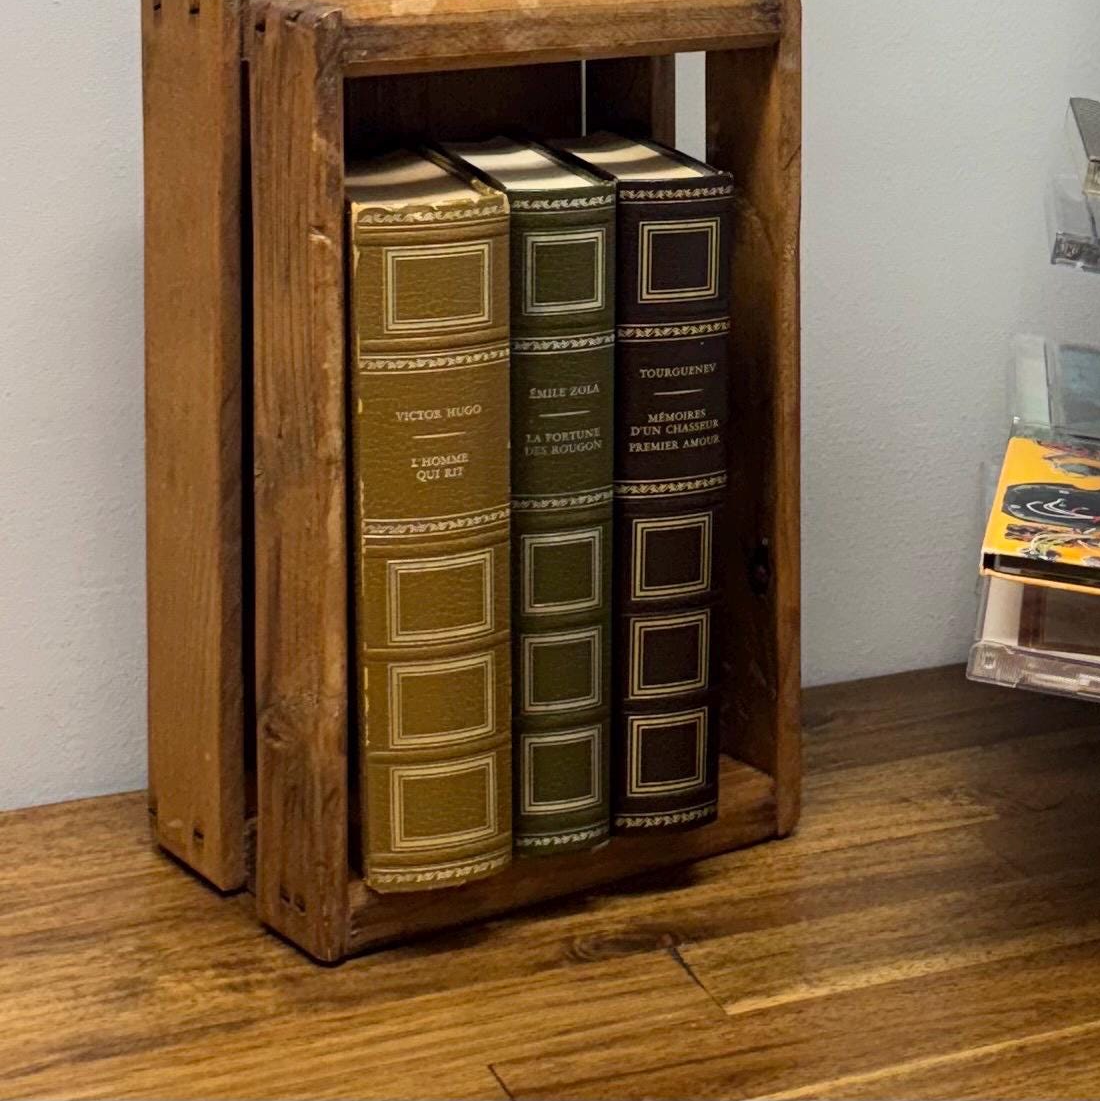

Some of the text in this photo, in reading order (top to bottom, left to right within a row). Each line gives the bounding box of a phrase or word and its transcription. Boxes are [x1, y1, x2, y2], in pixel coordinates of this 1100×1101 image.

[640, 362, 717, 378] TOURGUENEV
[529, 383, 600, 399] ÉMILE ZOLA
[396, 404, 482, 421] VICTOR HUGO
[648, 408, 706, 423] MÉMOIRES
[526, 427, 600, 443] LA FORTUNE
[630, 419, 719, 436] D'UN CHASSEUR
[551, 439, 602, 455] ROUGON
[628, 434, 720, 453] PREMIER AMOUR
[411, 453, 469, 468] L'HOMME
[416, 466, 464, 482] QUI RIT
